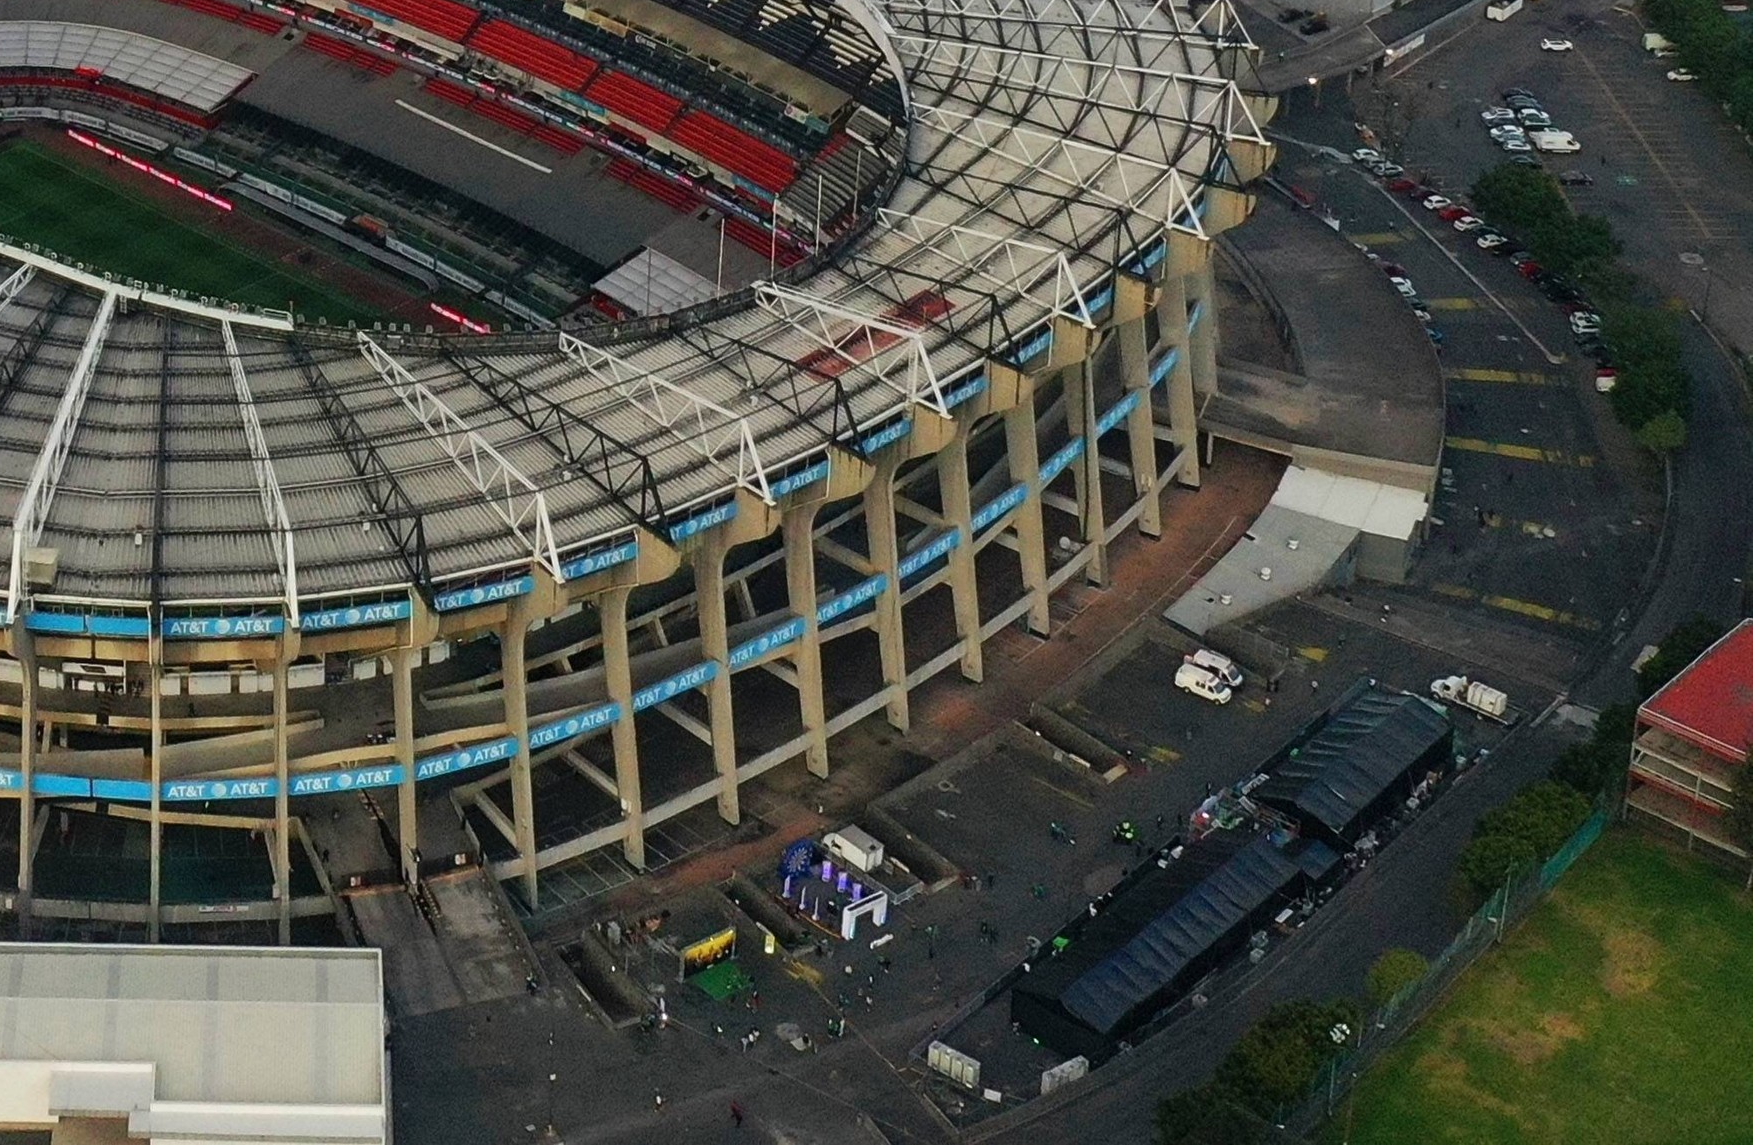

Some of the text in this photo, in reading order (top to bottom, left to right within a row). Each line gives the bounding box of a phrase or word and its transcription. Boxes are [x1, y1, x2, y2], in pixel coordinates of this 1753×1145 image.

[791, 466, 821, 488] AT&T
[699, 508, 729, 529] AT&T
[596, 546, 629, 568] AT&T
[488, 580, 523, 600] AT&T
[816, 580, 879, 624] AT&T AT&T
[170, 620, 273, 634] AT&T AT&T
[302, 604, 402, 629] AT&T AT&T
[729, 622, 798, 666] AT&T AT&T
[633, 666, 707, 709] AT&T AT&T
[530, 707, 613, 747] AT&T AT&T
[417, 742, 509, 778] AT&T AT&T
[167, 782, 269, 797] AT&T AT&T
[294, 769, 394, 792] AT&T AT&T
